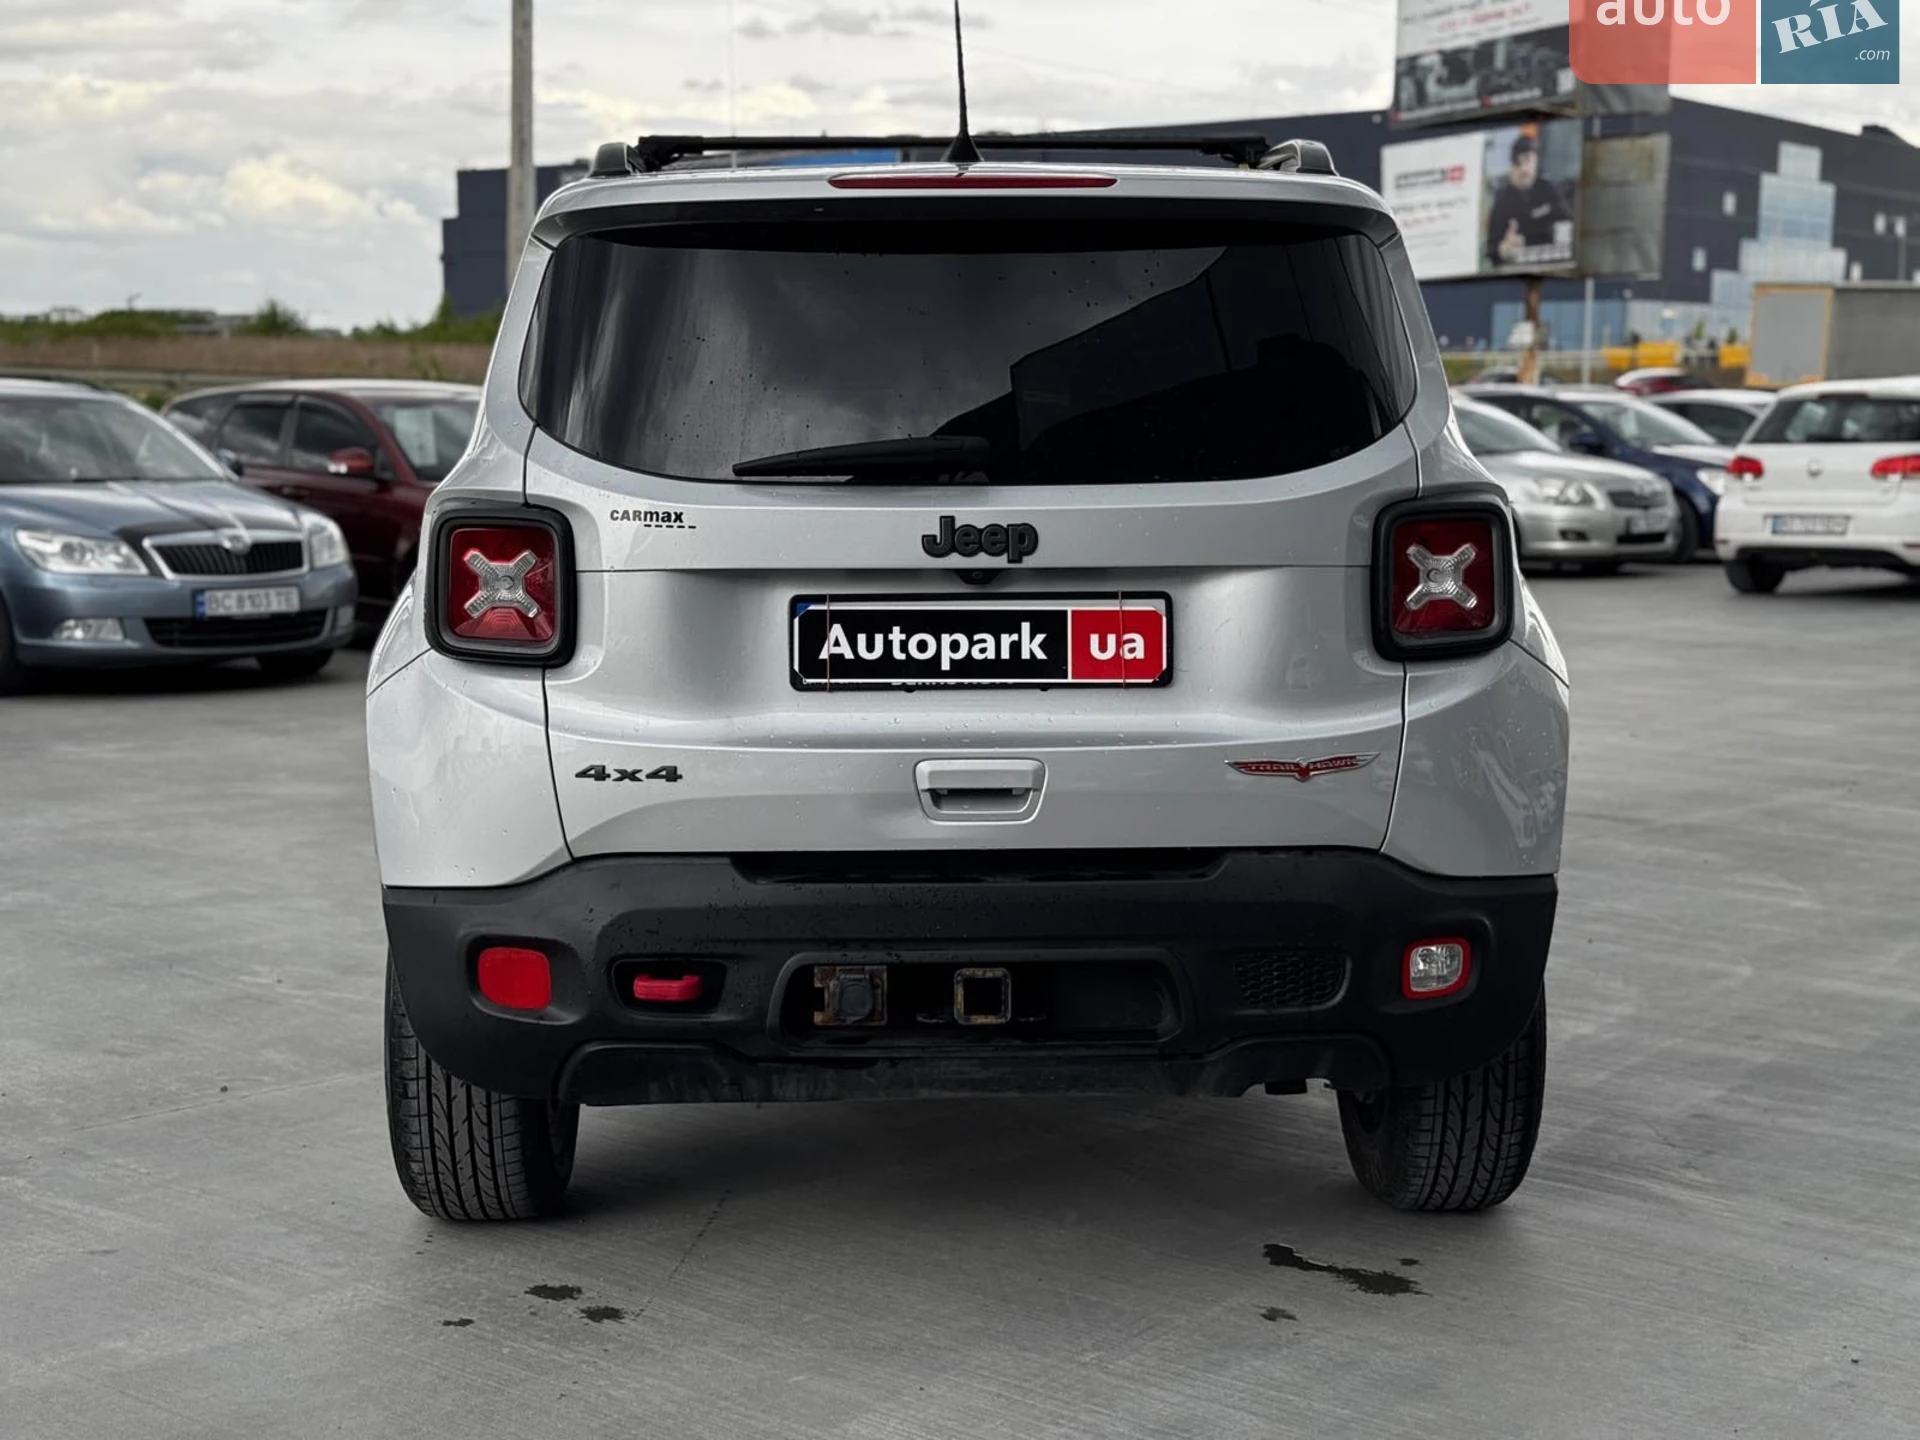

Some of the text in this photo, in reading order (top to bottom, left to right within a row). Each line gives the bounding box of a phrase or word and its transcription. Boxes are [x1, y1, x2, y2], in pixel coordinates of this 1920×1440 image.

[921, 515, 1039, 564] Jeep
[818, 621, 1145, 671] Autopark ua
[574, 764, 683, 782] 4x4
